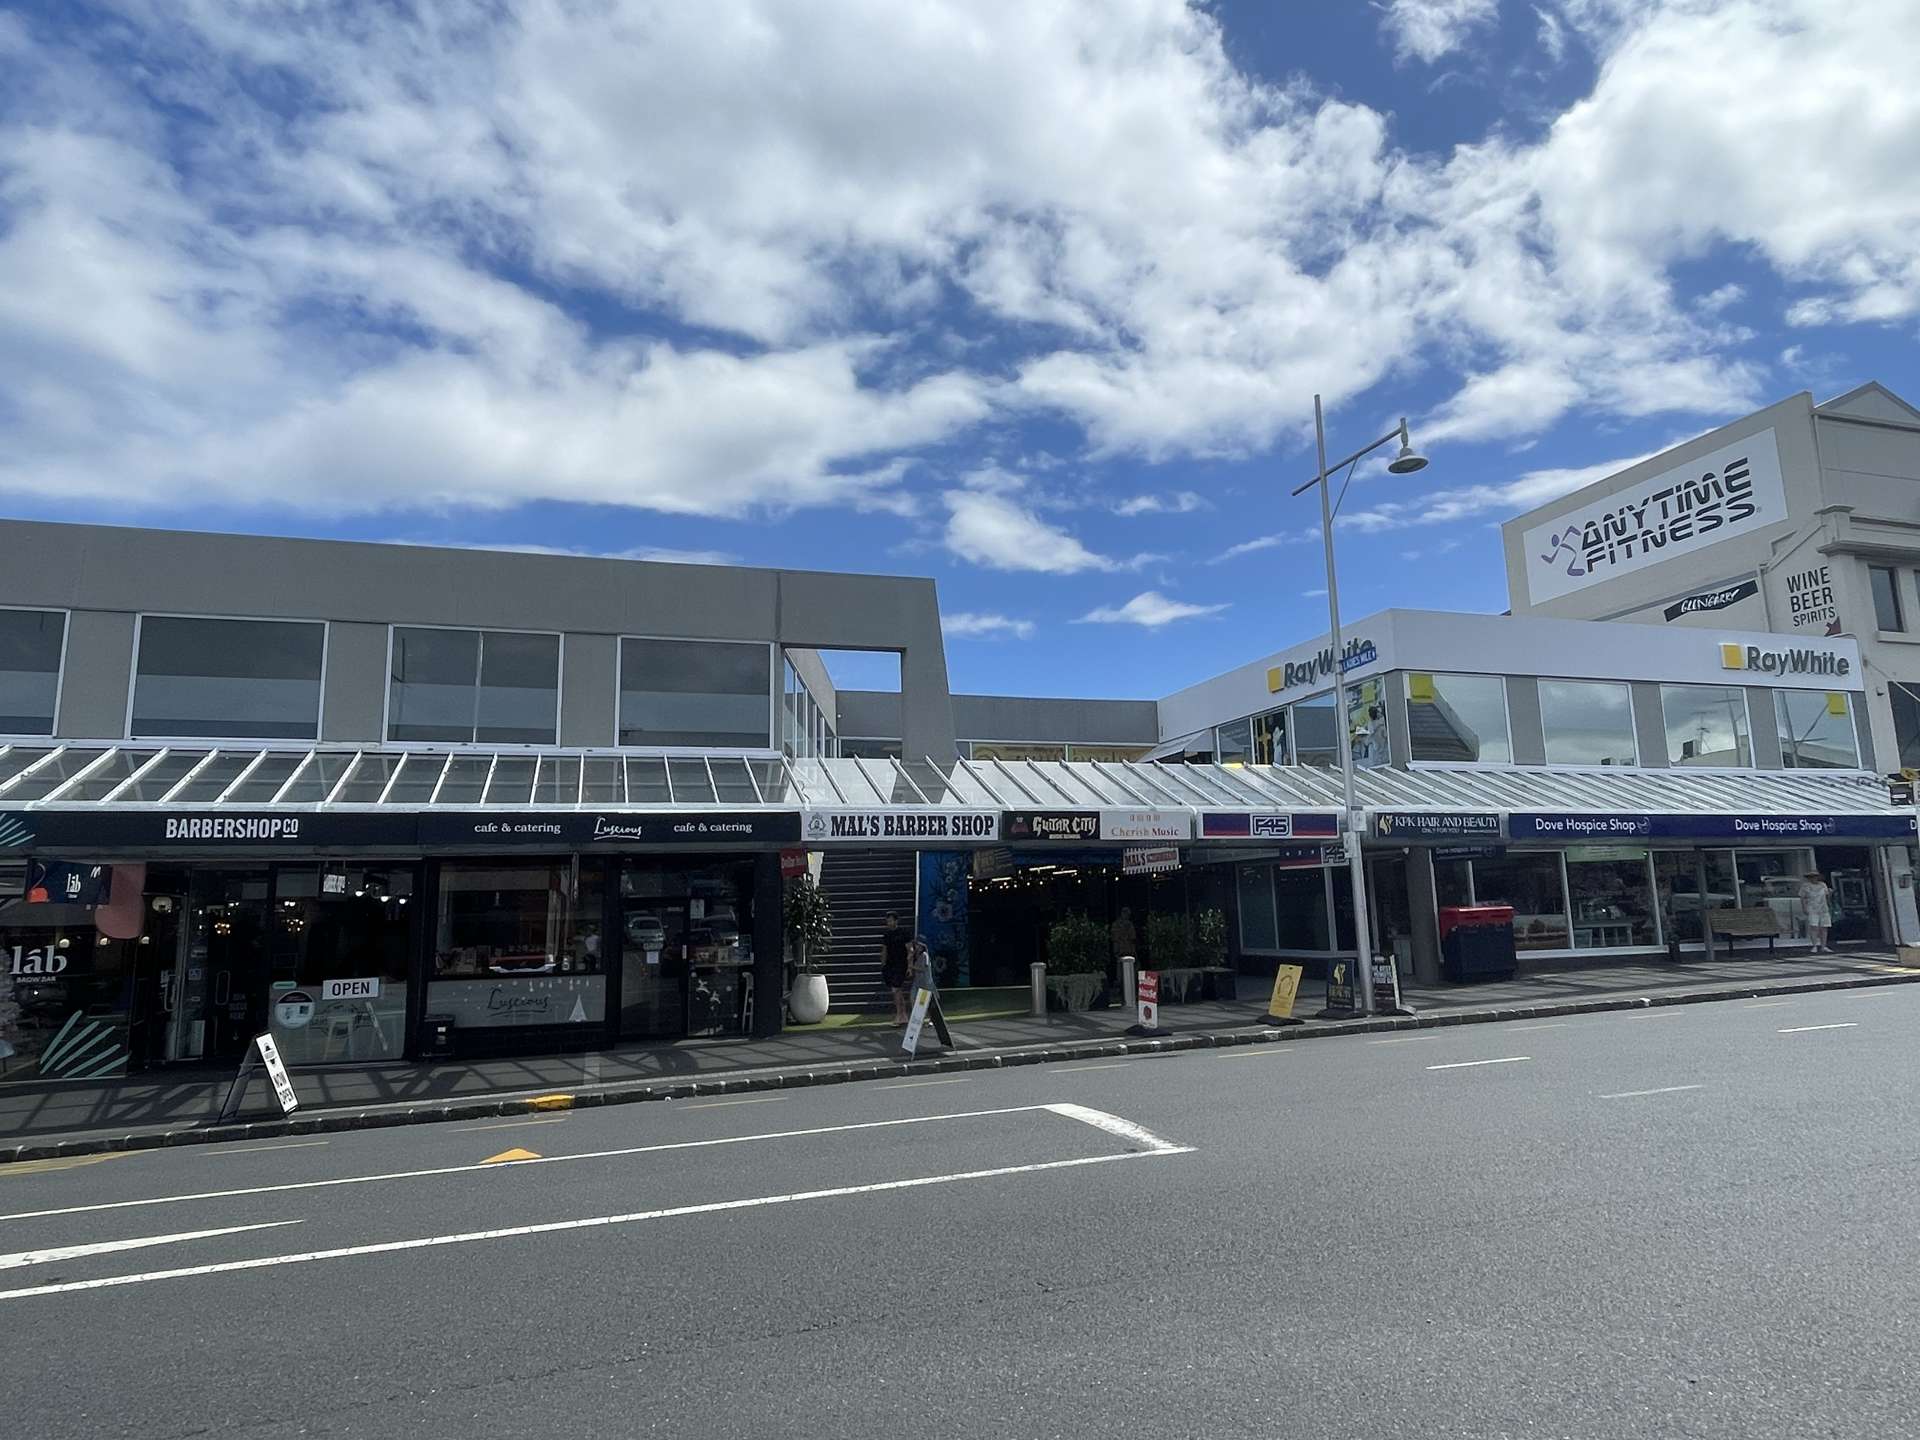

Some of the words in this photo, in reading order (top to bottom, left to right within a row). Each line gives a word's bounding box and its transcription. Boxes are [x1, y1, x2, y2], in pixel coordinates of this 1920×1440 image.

[1581, 457, 1752, 550] ANYTIME
[1585, 490, 1756, 573] FITNESS
[1786, 566, 1831, 594] WINE
[1680, 588, 1741, 614] GLENGARRY
[1790, 587, 1834, 613] BEER
[1792, 606, 1836, 627] SPIRITS
[474, 822, 498, 833] cafe
[501, 823, 512, 833] &
[514, 822, 561, 835] catering
[593, 816, 642, 837] Luscious
[673, 822, 696, 833] cafe
[698, 822, 708, 833] &
[710, 822, 752, 834] catering
[830, 815, 880, 837] MAL'S
[884, 814, 948, 836] BARBER
[952, 814, 995, 836] SHOP
[1111, 826, 1151, 837] Cherish
[1151, 826, 1180, 836] Music
[1253, 816, 1289, 836] F45
[1395, 817, 1415, 827] KPK
[1417, 817, 1440, 827] HAIR
[1442, 817, 1462, 827] AND
[1463, 816, 1497, 827] BEAUTY
[1535, 818, 1564, 831] Dove
[1566, 817, 1607, 834] Hospice
[1609, 817, 1636, 834] Shop
[1735, 818, 1759, 831] Dove
[1761, 818, 1797, 833] Hospice
[1799, 818, 1823, 834] Shop
[331, 981, 370, 996] OPEN
